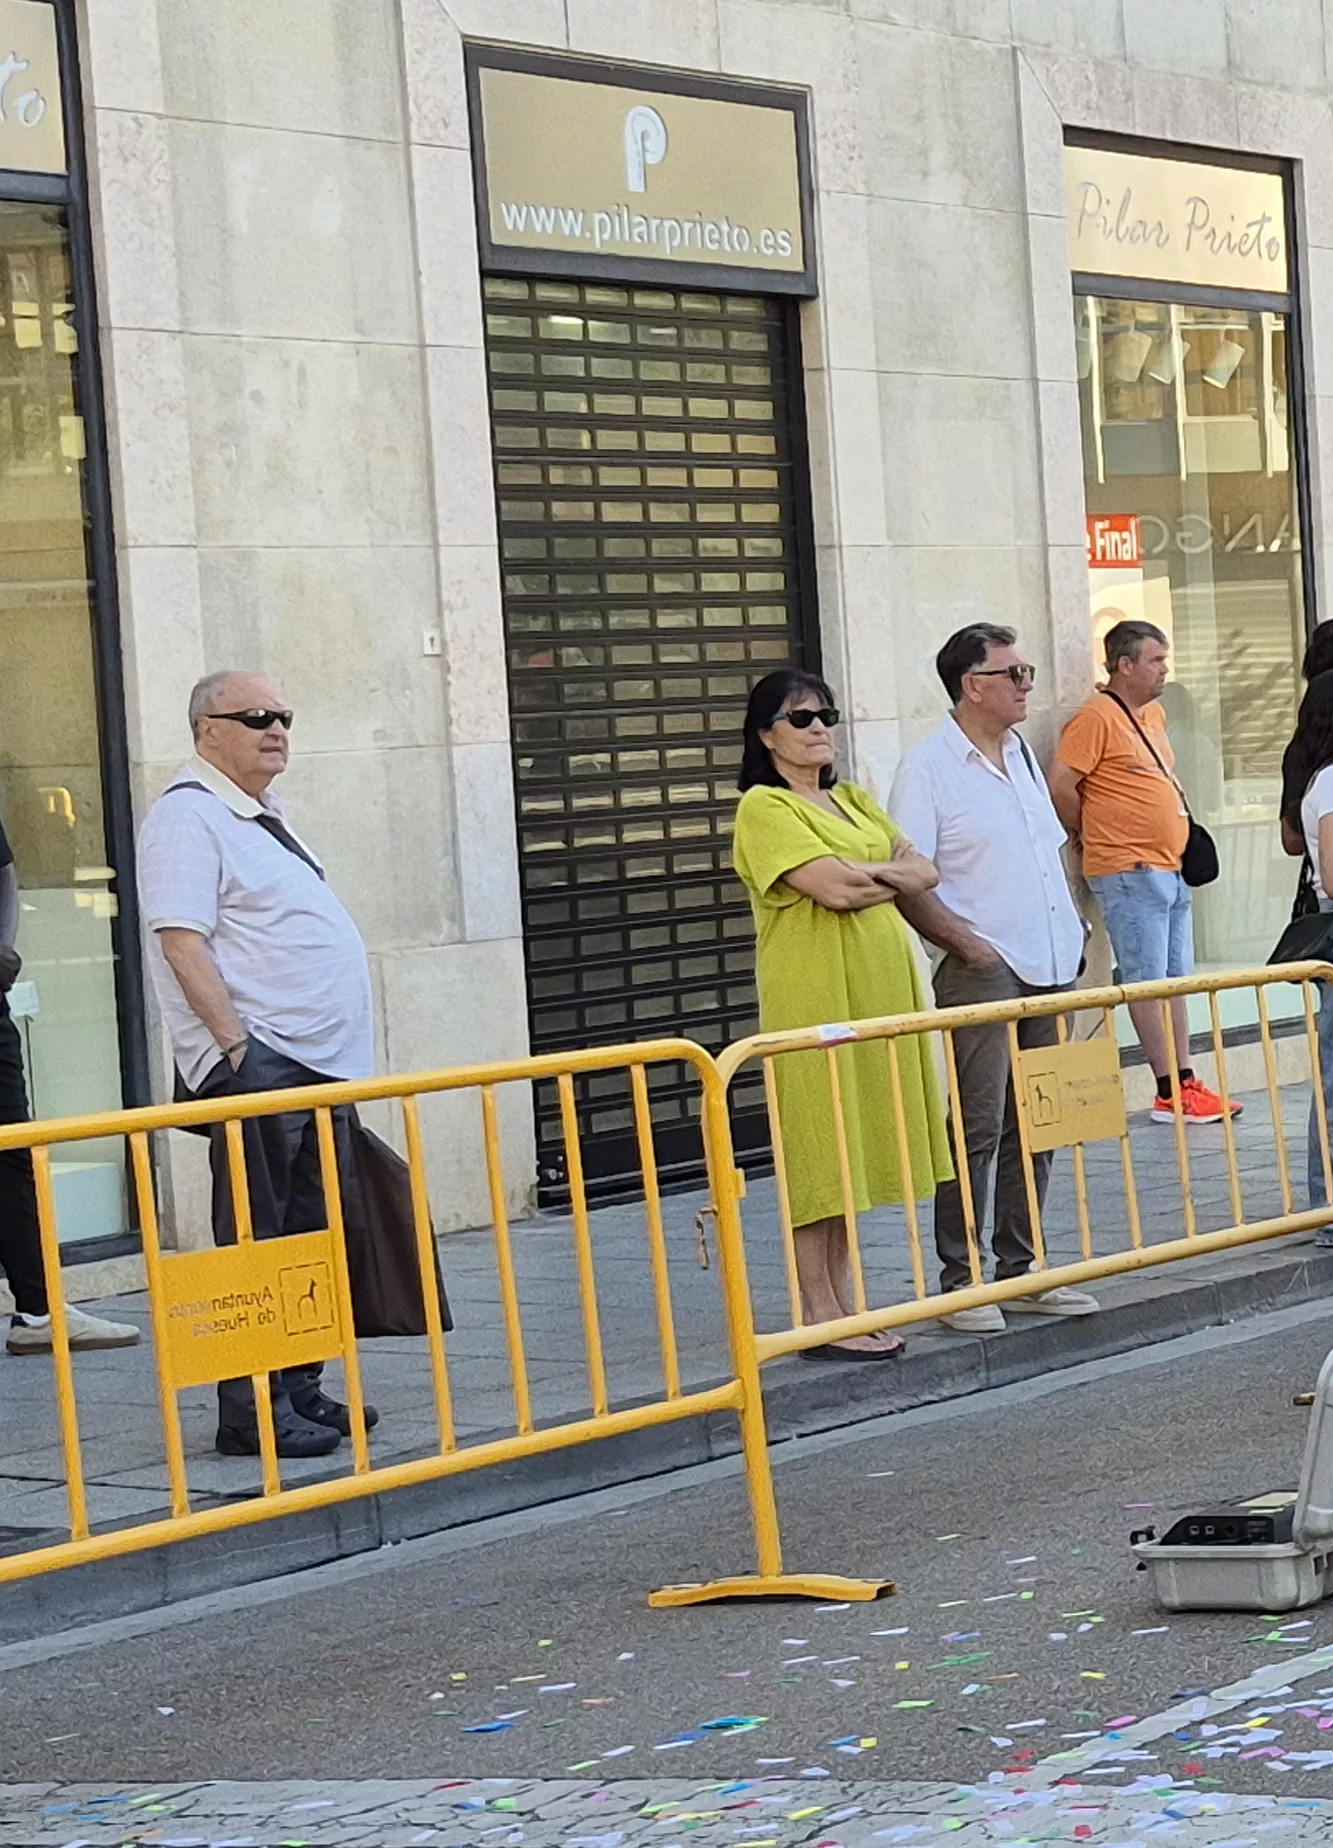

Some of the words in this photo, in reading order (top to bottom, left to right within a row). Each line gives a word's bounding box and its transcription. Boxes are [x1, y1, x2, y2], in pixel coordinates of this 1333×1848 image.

[500, 202, 793, 257] www.pilarprieto.es
[1076, 181, 1169, 249] Pilar
[1185, 196, 1280, 262] Prieto
[1094, 517, 1138, 561] Final
